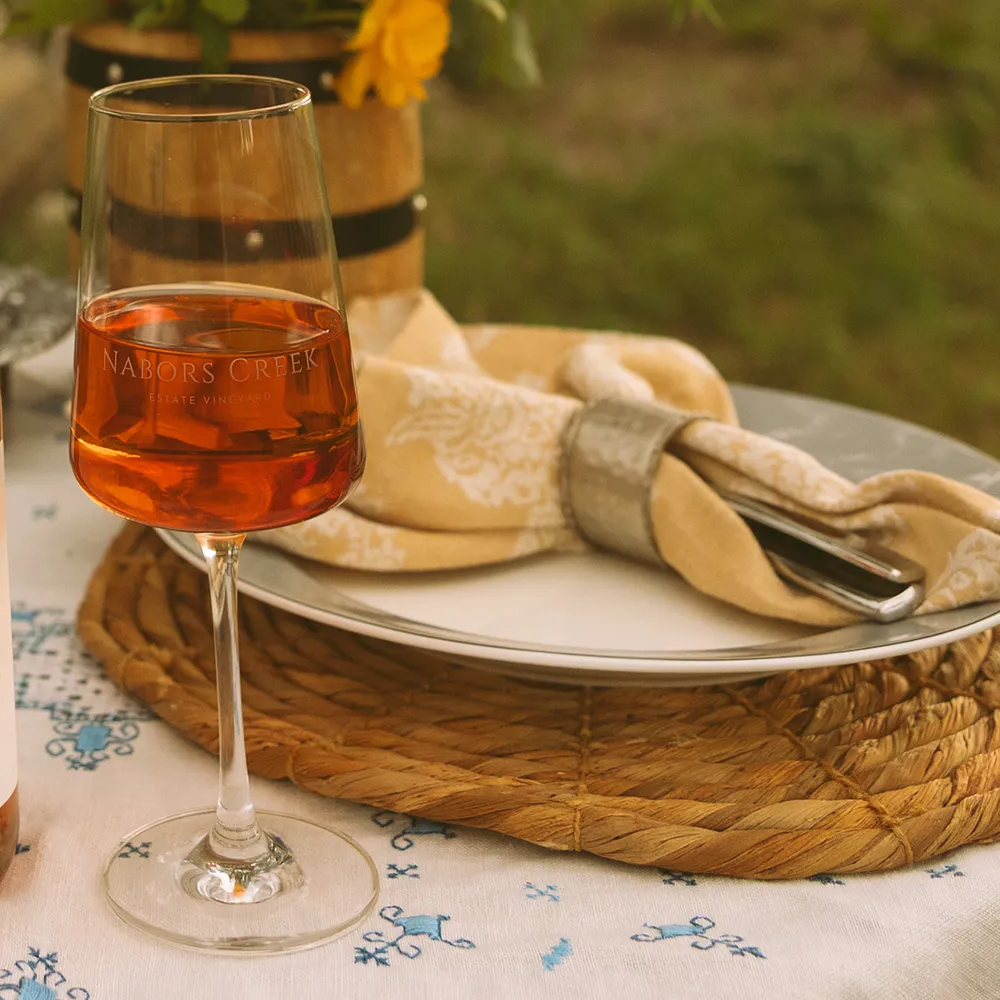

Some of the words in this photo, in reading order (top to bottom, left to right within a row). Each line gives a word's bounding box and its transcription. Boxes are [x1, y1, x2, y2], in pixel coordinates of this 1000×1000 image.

[102, 347, 215, 384] NABORS
[228, 347, 319, 383] CREEK
[149, 392, 196, 405] ESTATE
[203, 391, 271, 405] VINEYARD
